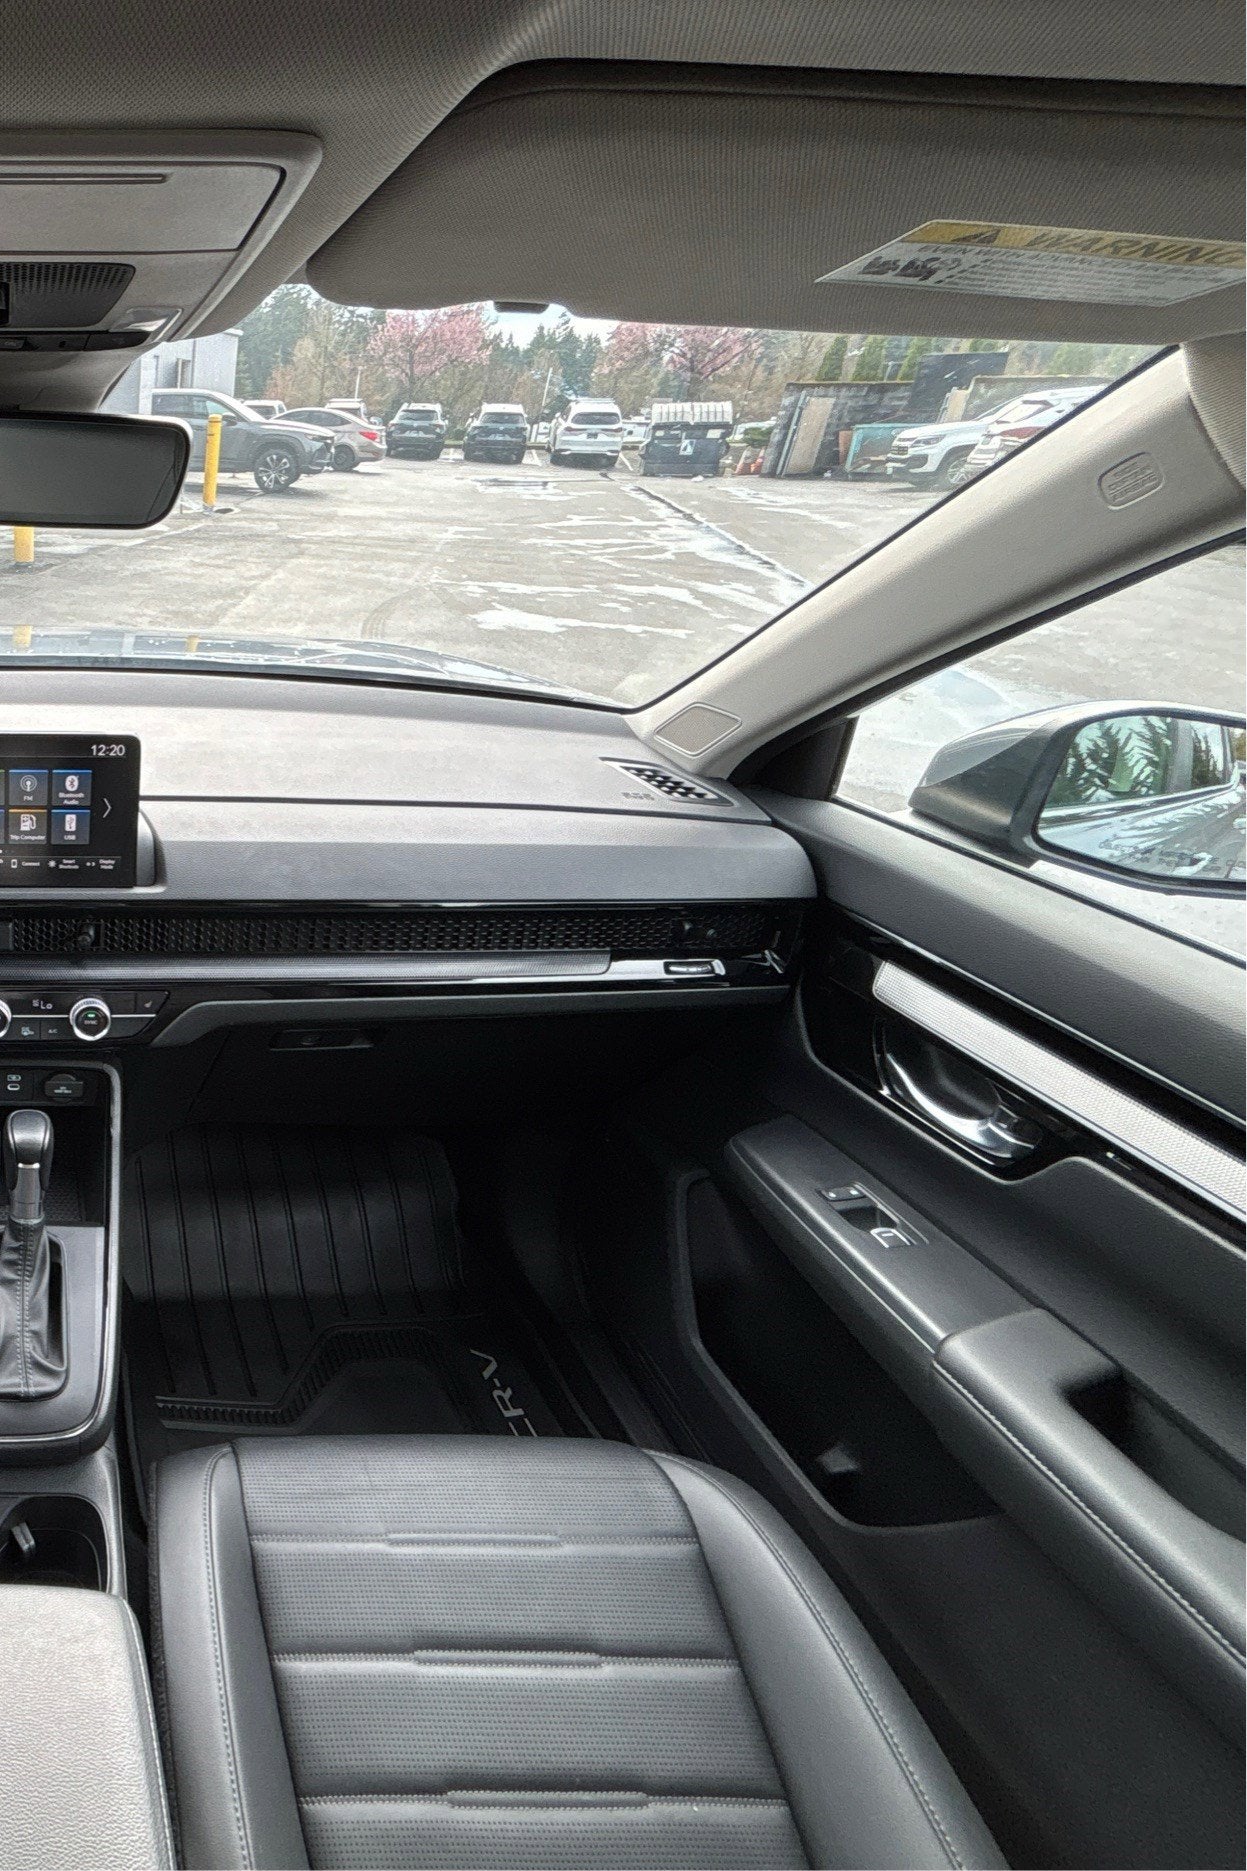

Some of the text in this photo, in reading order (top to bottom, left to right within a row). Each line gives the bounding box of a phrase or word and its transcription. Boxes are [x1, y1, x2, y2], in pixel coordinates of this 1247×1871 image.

[1024, 231, 1247, 265] WARNING
[90, 744, 126, 756] 12:20
[40, 1000, 53, 1010] Lo
